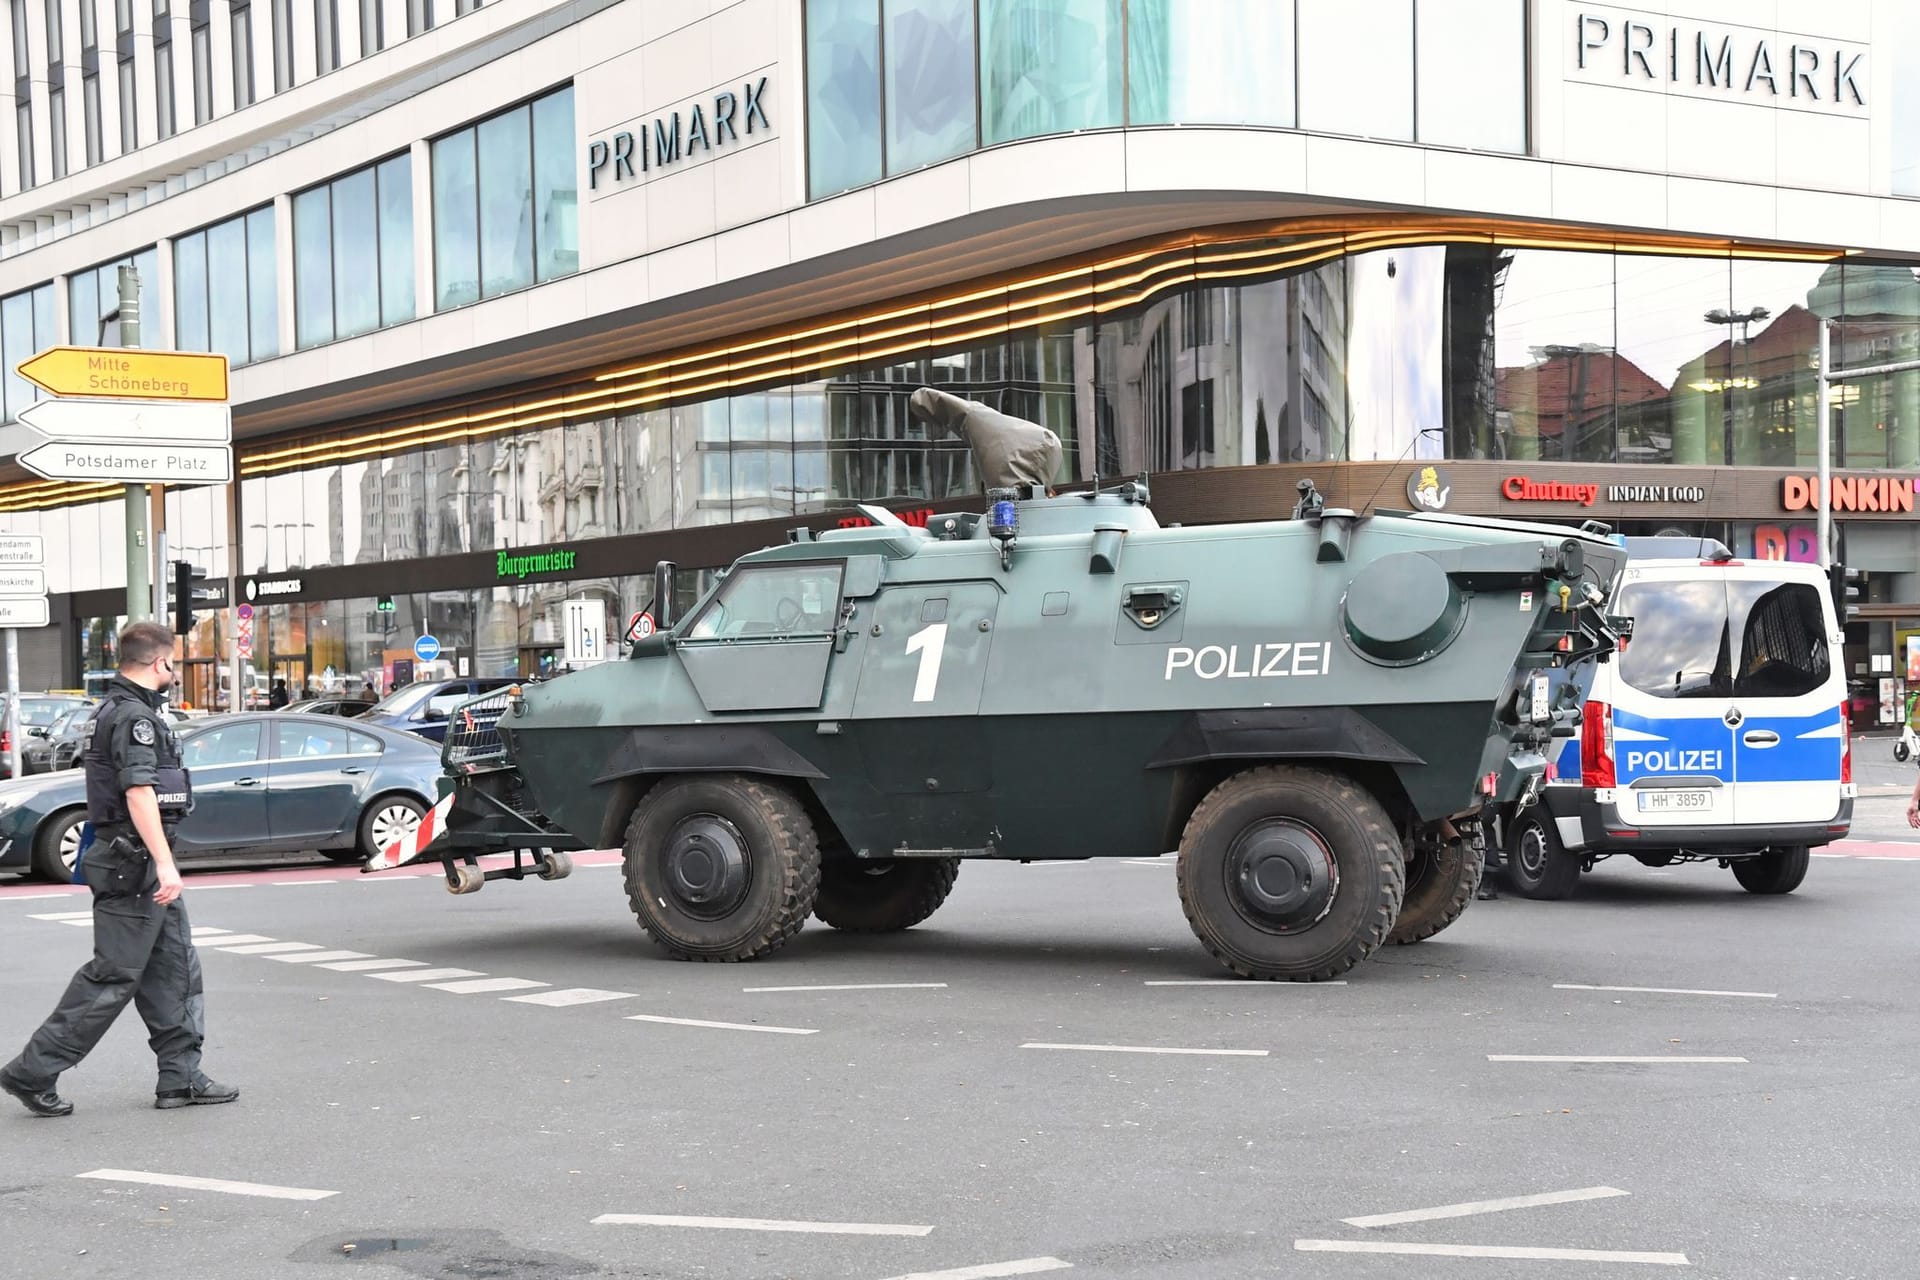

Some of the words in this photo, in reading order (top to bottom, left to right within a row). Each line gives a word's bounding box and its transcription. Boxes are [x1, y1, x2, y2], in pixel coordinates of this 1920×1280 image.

[1577, 13, 1867, 105] PRIMARK
[588, 76, 769, 190] PRIMARK
[88, 357, 130, 371] Mitte
[89, 375, 189, 395] Schöneberg
[65, 453, 158, 470] Potsdamer
[167, 456, 207, 471] Platz
[1502, 476, 1600, 507] Chutney
[1608, 485, 1661, 502] INDIAN
[497, 548, 576, 579] Burgermeister
[1627, 569, 1640, 580] 32
[258, 579, 302, 596] STARBUCKS
[634, 620, 650, 634] 30
[905, 623, 949, 702] 1
[1164, 642, 1332, 681] POLIZEI
[1627, 749, 1723, 772] POLIZEI
[1651, 794, 1669, 807] HH
[1676, 793, 1706, 807] 3859
